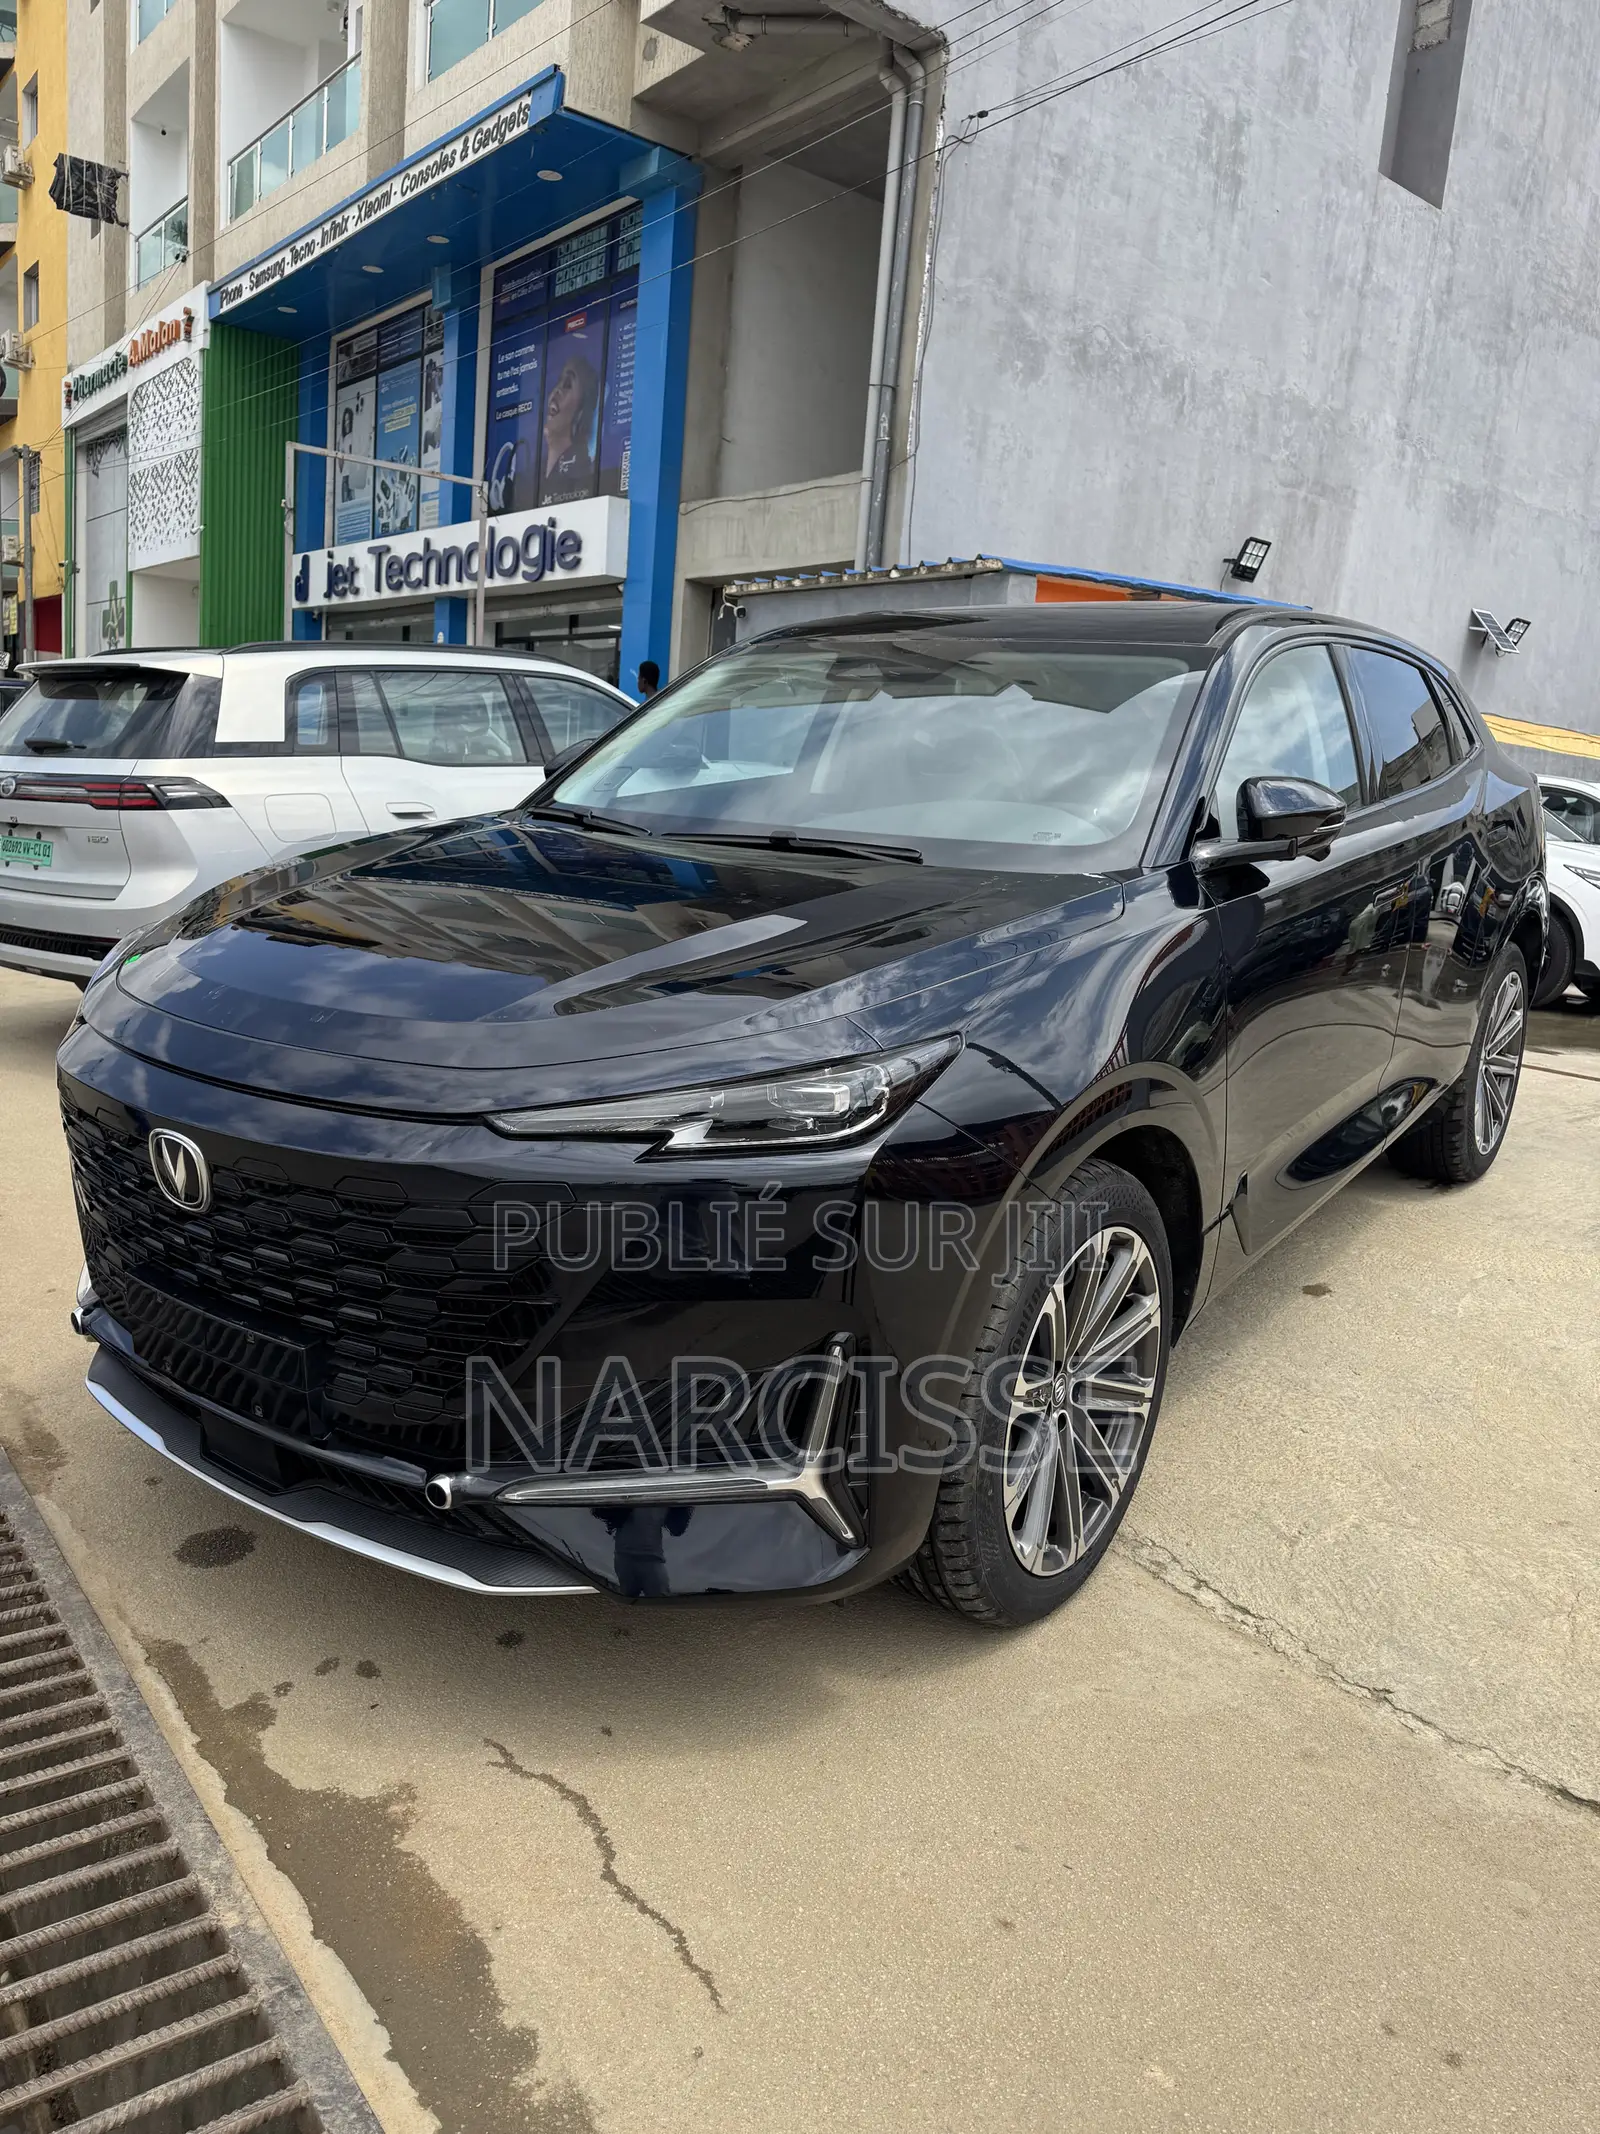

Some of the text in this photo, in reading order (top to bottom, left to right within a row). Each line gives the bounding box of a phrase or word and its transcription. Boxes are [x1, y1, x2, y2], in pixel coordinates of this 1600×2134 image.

[249, 256, 286, 291] Samsung
[289, 238, 316, 267] Tecno
[319, 214, 350, 249] Infinix
[354, 183, 393, 227] Xiaomi
[400, 147, 457, 197] Consoles
[459, 137, 470, 163] &
[471, 101, 531, 155] Gadgets
[73, 319, 182, 402] Pharmacie A.Malan
[498, 344, 536, 364] Le son comme
[519, 358, 538, 376] jamais
[323, 550, 361, 600] jet
[367, 516, 583, 593] Technologie
